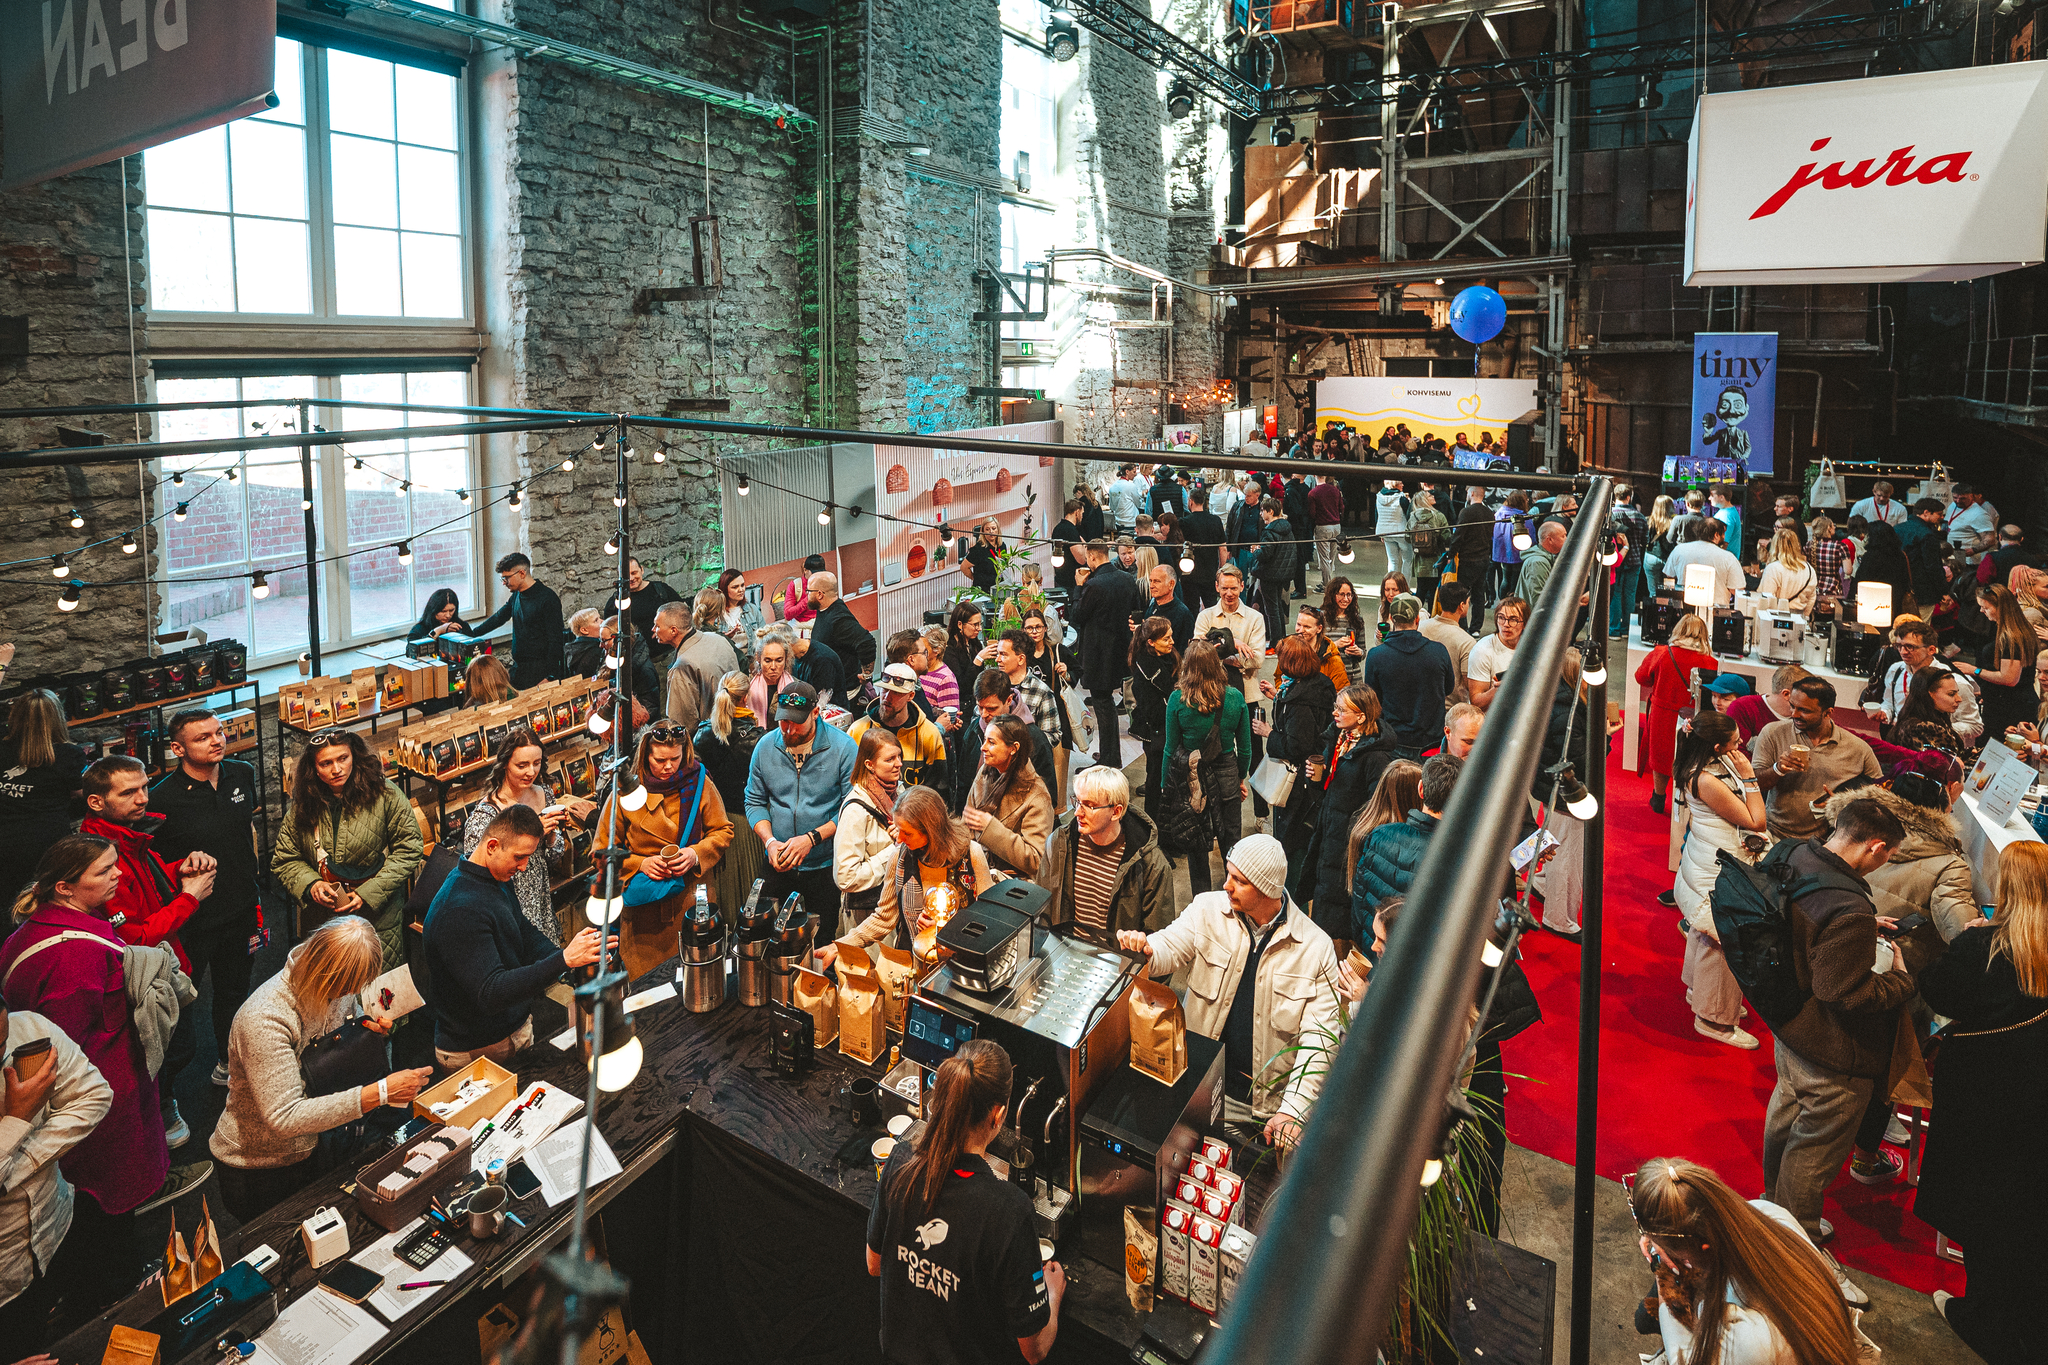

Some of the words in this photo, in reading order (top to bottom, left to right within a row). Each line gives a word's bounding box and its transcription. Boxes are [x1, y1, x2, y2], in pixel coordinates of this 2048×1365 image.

[1748, 137, 1973, 220] jura
[1697, 350, 1771, 388] tiny
[1720, 379, 1742, 387] giant
[1407, 389, 1452, 397] KOHVISEMU
[897, 1245, 961, 1292] ROCKET
[908, 1265, 949, 1302] BEAN
[1028, 1297, 1046, 1313] TEAM
